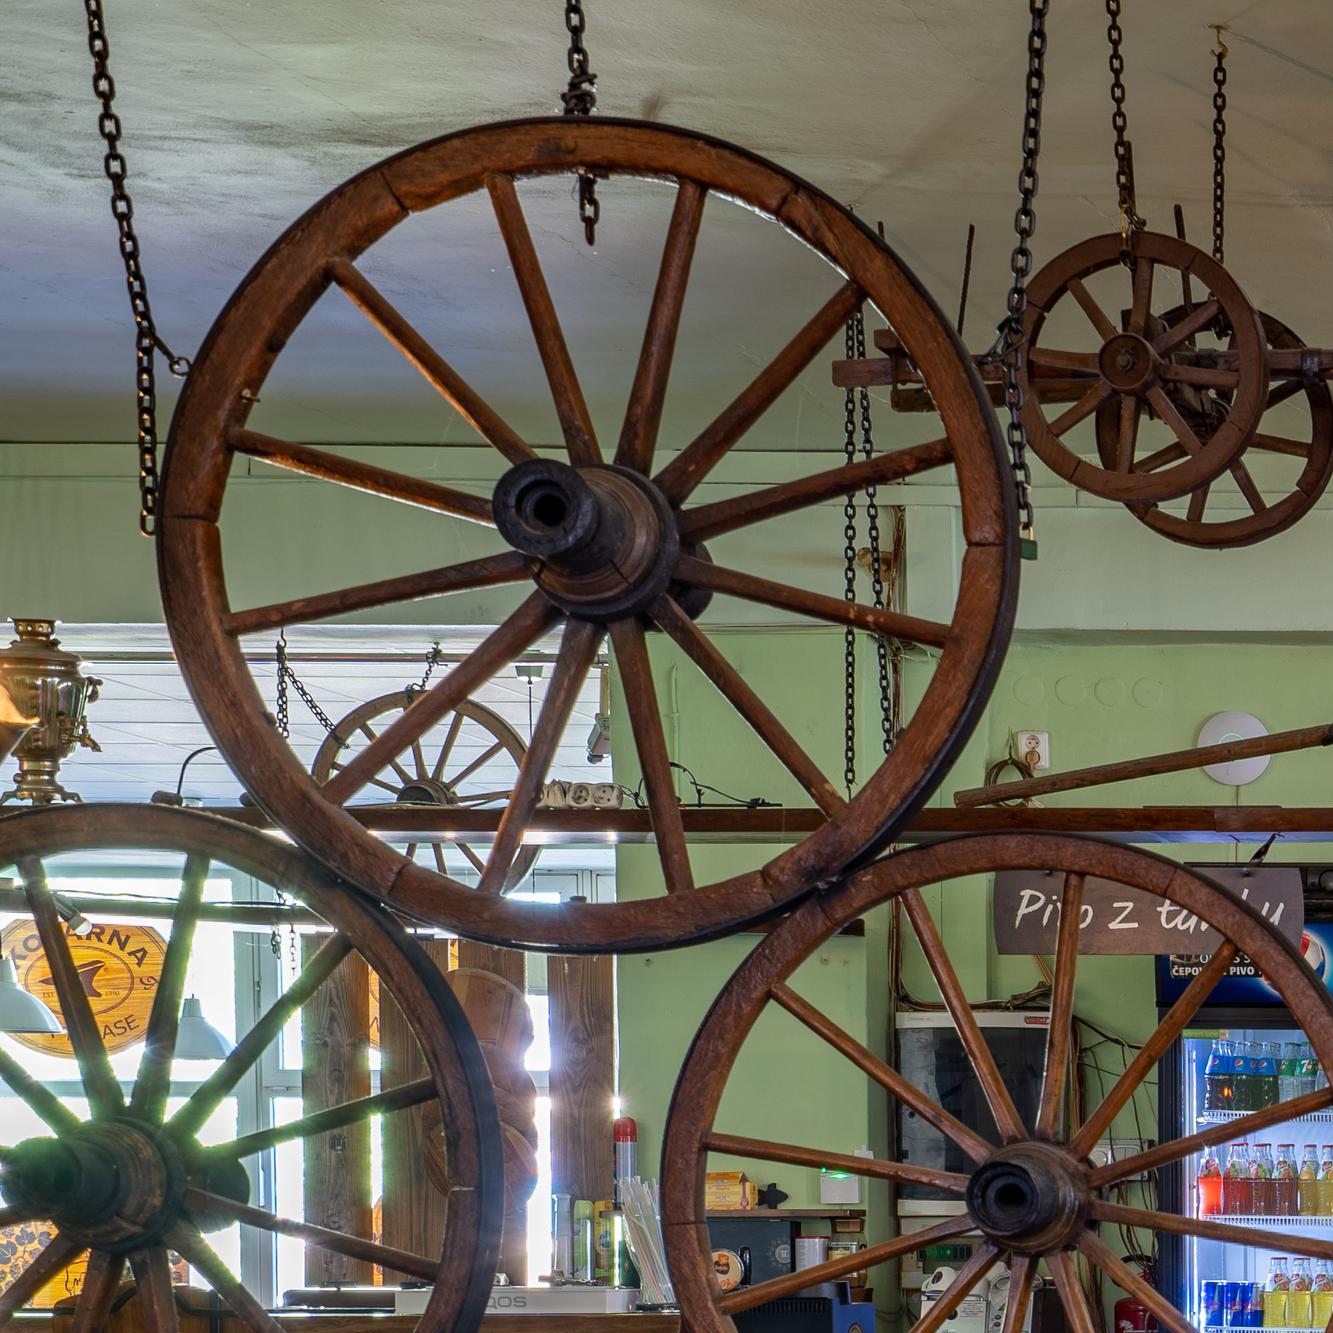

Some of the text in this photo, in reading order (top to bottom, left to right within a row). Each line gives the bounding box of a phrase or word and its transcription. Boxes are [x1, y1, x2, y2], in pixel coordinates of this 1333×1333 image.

[1015, 888, 1094, 929] Pio
[1108, 901, 1139, 929] z
[1229, 966, 1255, 976] PIVO
[489, 1296, 527, 1309] QOS
